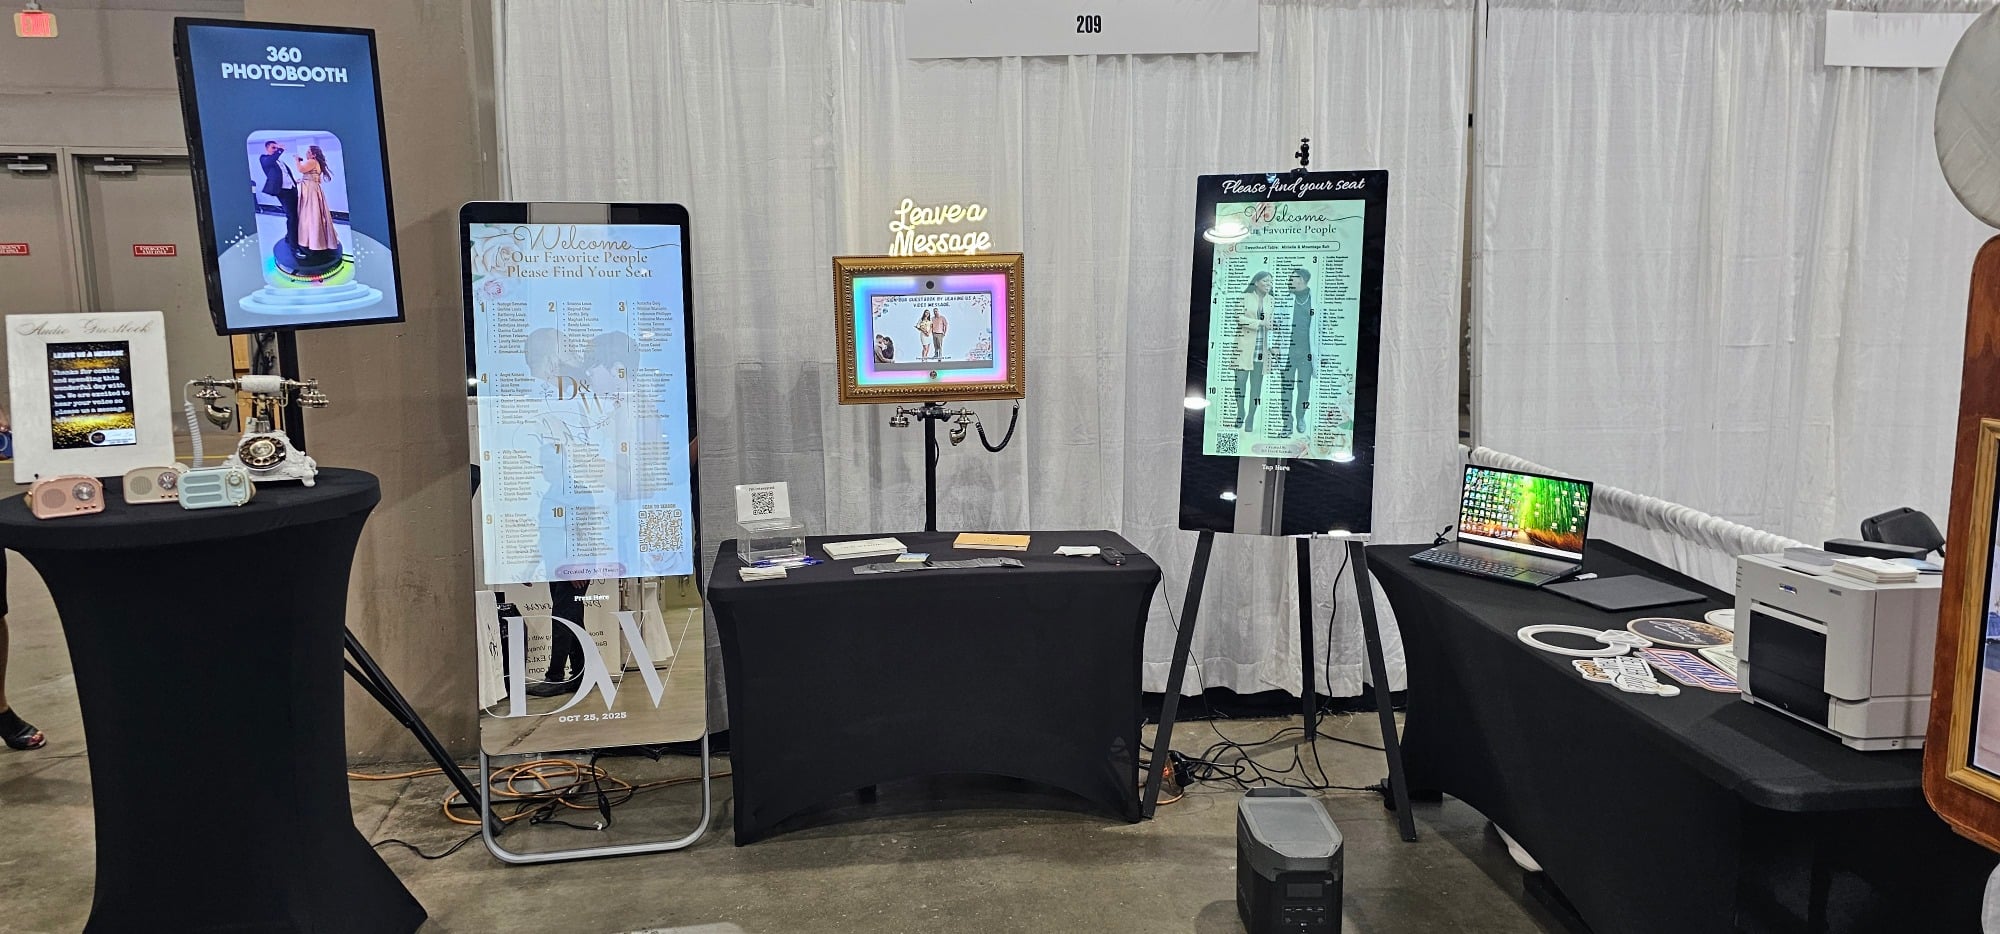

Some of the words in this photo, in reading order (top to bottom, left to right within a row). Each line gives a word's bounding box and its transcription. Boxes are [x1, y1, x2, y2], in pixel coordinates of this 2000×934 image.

[1076, 15, 1102, 34] 209
[266, 46, 302, 64] 360
[221, 62, 348, 83] PHOTOBOOTH
[1222, 179, 1267, 195] Please
[1266, 177, 1301, 199] find
[1297, 181, 1334, 198] your
[1335, 178, 1366, 191] seat
[888, 198, 967, 232] Leave
[966, 203, 988, 222] a
[1243, 203, 1327, 223] Welcome
[1263, 226, 1302, 235] Favorite
[1305, 224, 1337, 237] People
[512, 225, 633, 250] Welcome
[888, 230, 992, 257] Message
[511, 251, 540, 263] Our
[544, 251, 600, 263] Favorite
[604, 250, 648, 268] People
[507, 265, 549, 278] Please
[553, 265, 583, 278] Find
[588, 266, 621, 278] Your
[625, 266, 653, 278] Seat
[479, 301, 485, 312] 1
[548, 302, 555, 312] 2
[619, 301, 625, 312] 3
[481, 372, 488, 384] 4
[618, 368, 625, 379] 5
[554, 443, 561, 454] 7
[620, 441, 628, 453] 8
[483, 450, 490, 461] 6
[1261, 463, 1274, 472] Tap
[1274, 464, 1291, 472] Here
[551, 507, 565, 518] 10
[573, 595, 593, 603] Press
[593, 593, 610, 602] Here
[558, 715, 580, 723] OCT
[583, 714, 600, 723] 25,
[602, 711, 627, 721] 2025
